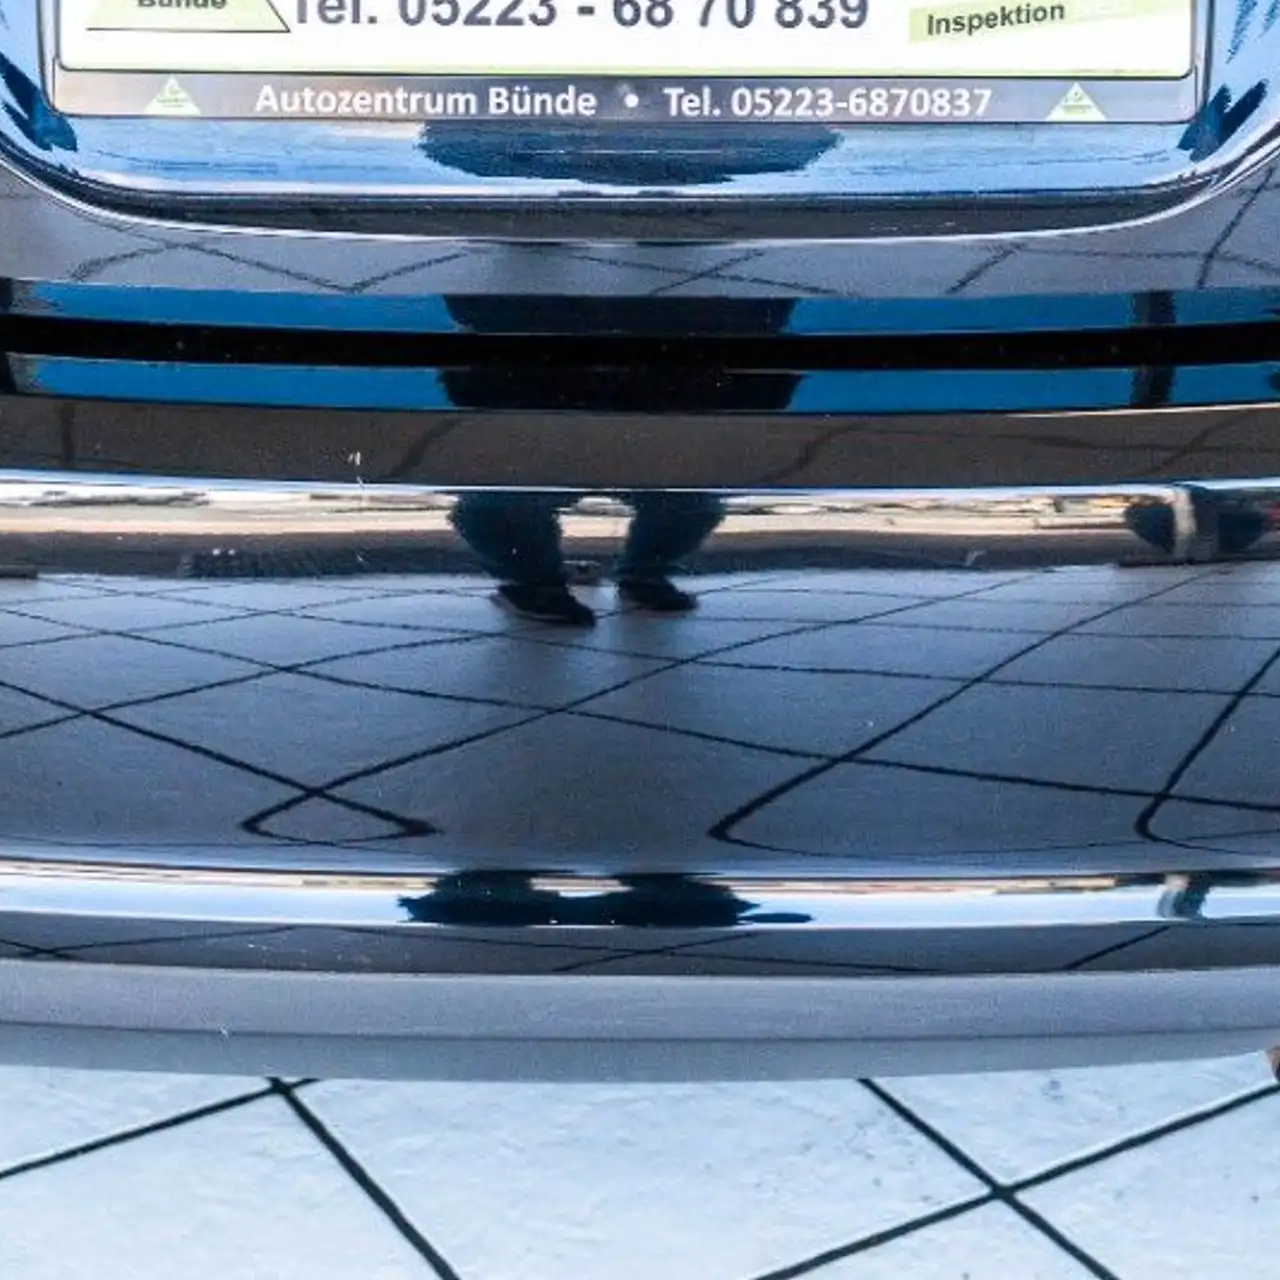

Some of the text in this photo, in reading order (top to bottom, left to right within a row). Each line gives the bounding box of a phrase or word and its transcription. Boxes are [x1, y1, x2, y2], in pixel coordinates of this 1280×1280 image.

[926, 1, 1066, 37] Inspektion
[255, 84, 992, 118] Autozentrum Bünde Tel. 05223-6870837
